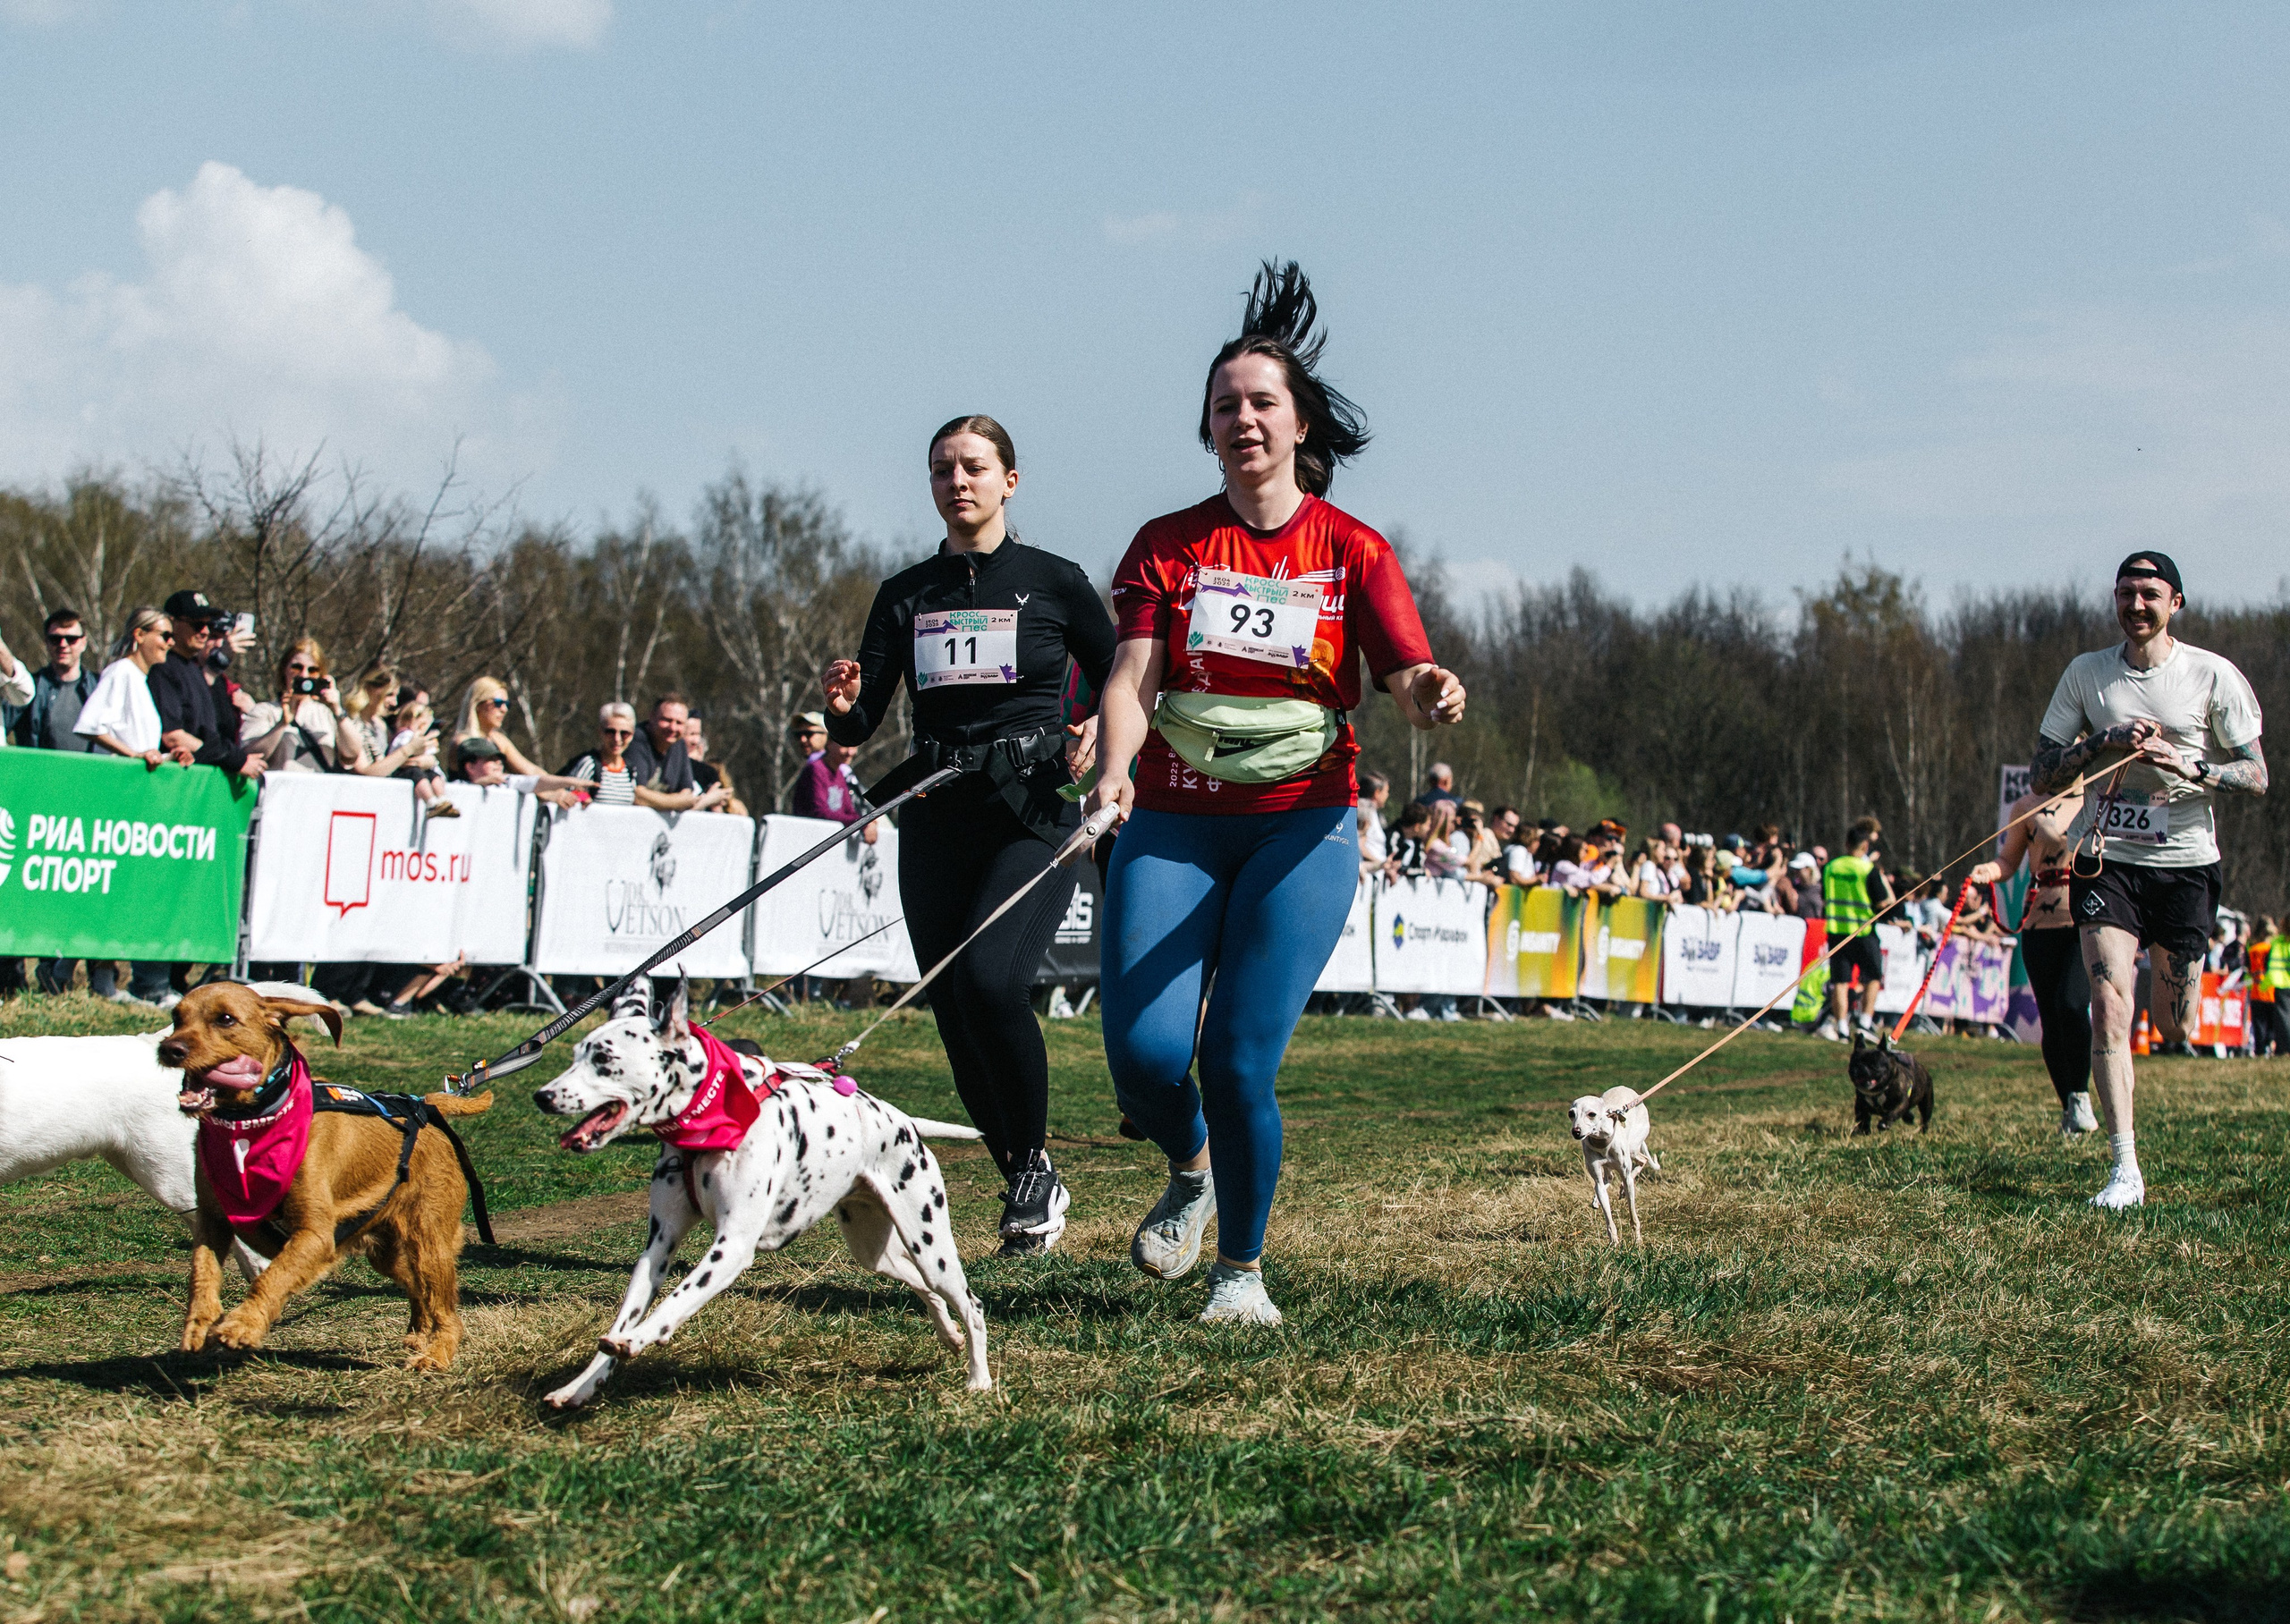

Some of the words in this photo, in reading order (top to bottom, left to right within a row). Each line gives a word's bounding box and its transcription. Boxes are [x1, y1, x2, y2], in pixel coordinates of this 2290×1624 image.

[1230, 605, 1275, 638] 93
[945, 637, 976, 665] 11
[1169, 762, 1178, 788] 2022
[2108, 806, 2150, 830] 326
[27, 814, 85, 853] РИА
[91, 818, 216, 861] НОВОСТИ
[22, 854, 117, 894] СПОРТ
[381, 850, 472, 883] mos.ru
[682, 1070, 725, 1124] ВМЕСТЕ
